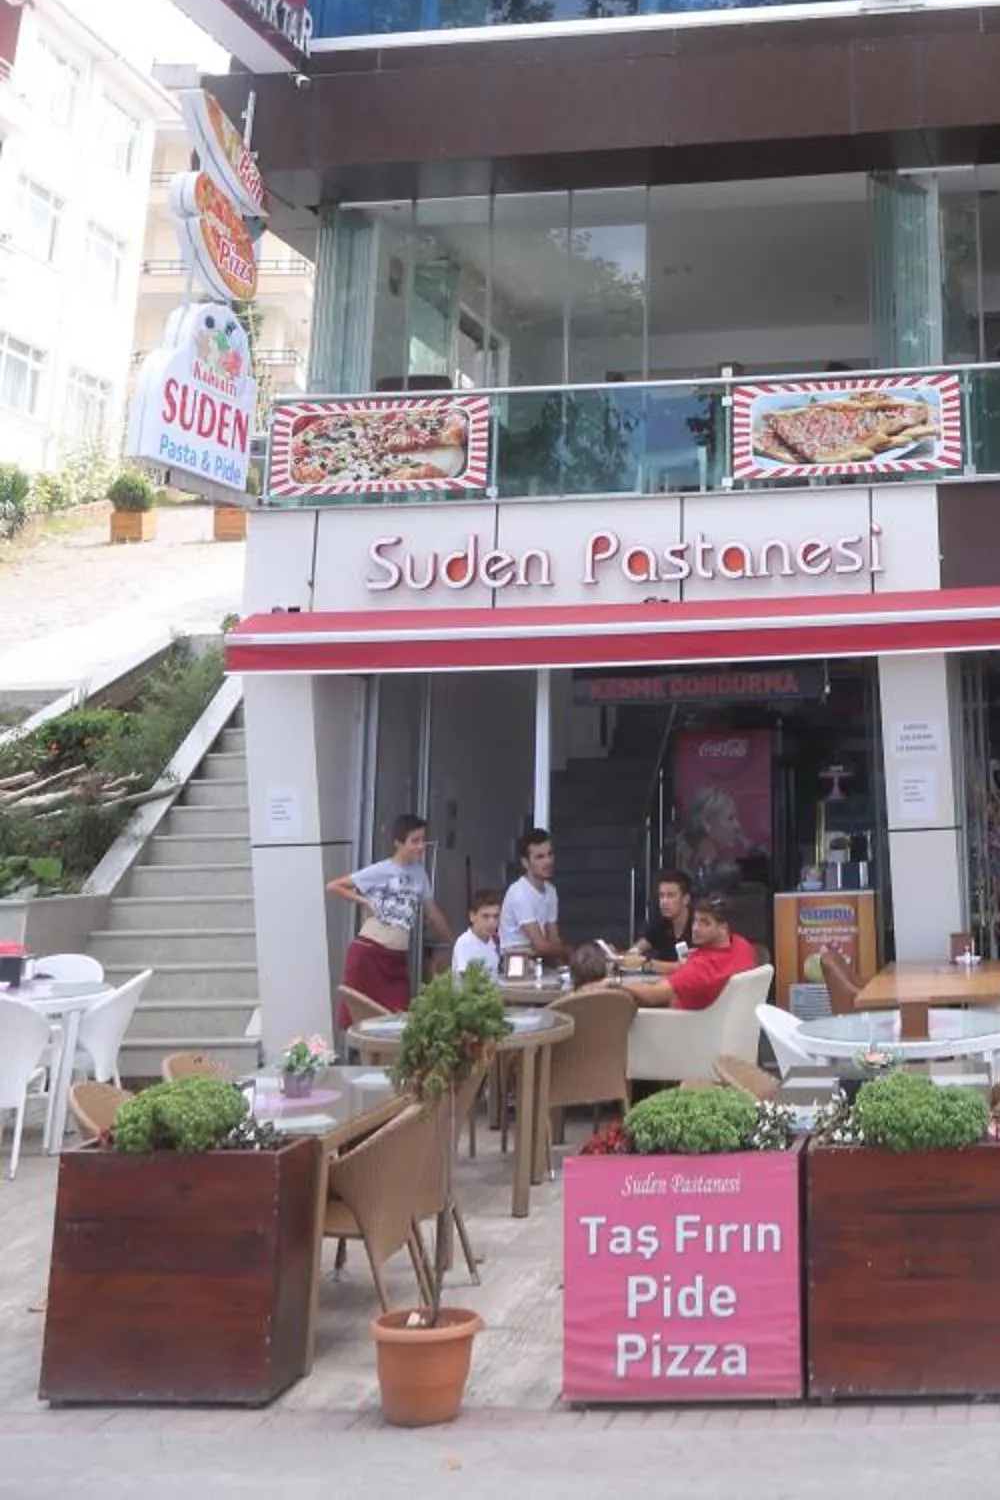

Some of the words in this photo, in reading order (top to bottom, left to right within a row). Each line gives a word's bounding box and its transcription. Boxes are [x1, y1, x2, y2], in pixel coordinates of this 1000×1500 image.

[162, 377, 249, 454] SUDEN
[160, 434, 197, 467] Pasta
[201, 450, 211, 472] &
[366, 534, 554, 592] Suden
[582, 522, 884, 583] Pastanesi
[621, 1172, 667, 1197] Suden
[670, 1171, 741, 1194] Pastanesi
[579, 1215, 659, 1260] Taş
[675, 1214, 782, 1254] Fırın
[627, 1274, 737, 1319] Pide
[617, 1332, 748, 1378] Pizza
